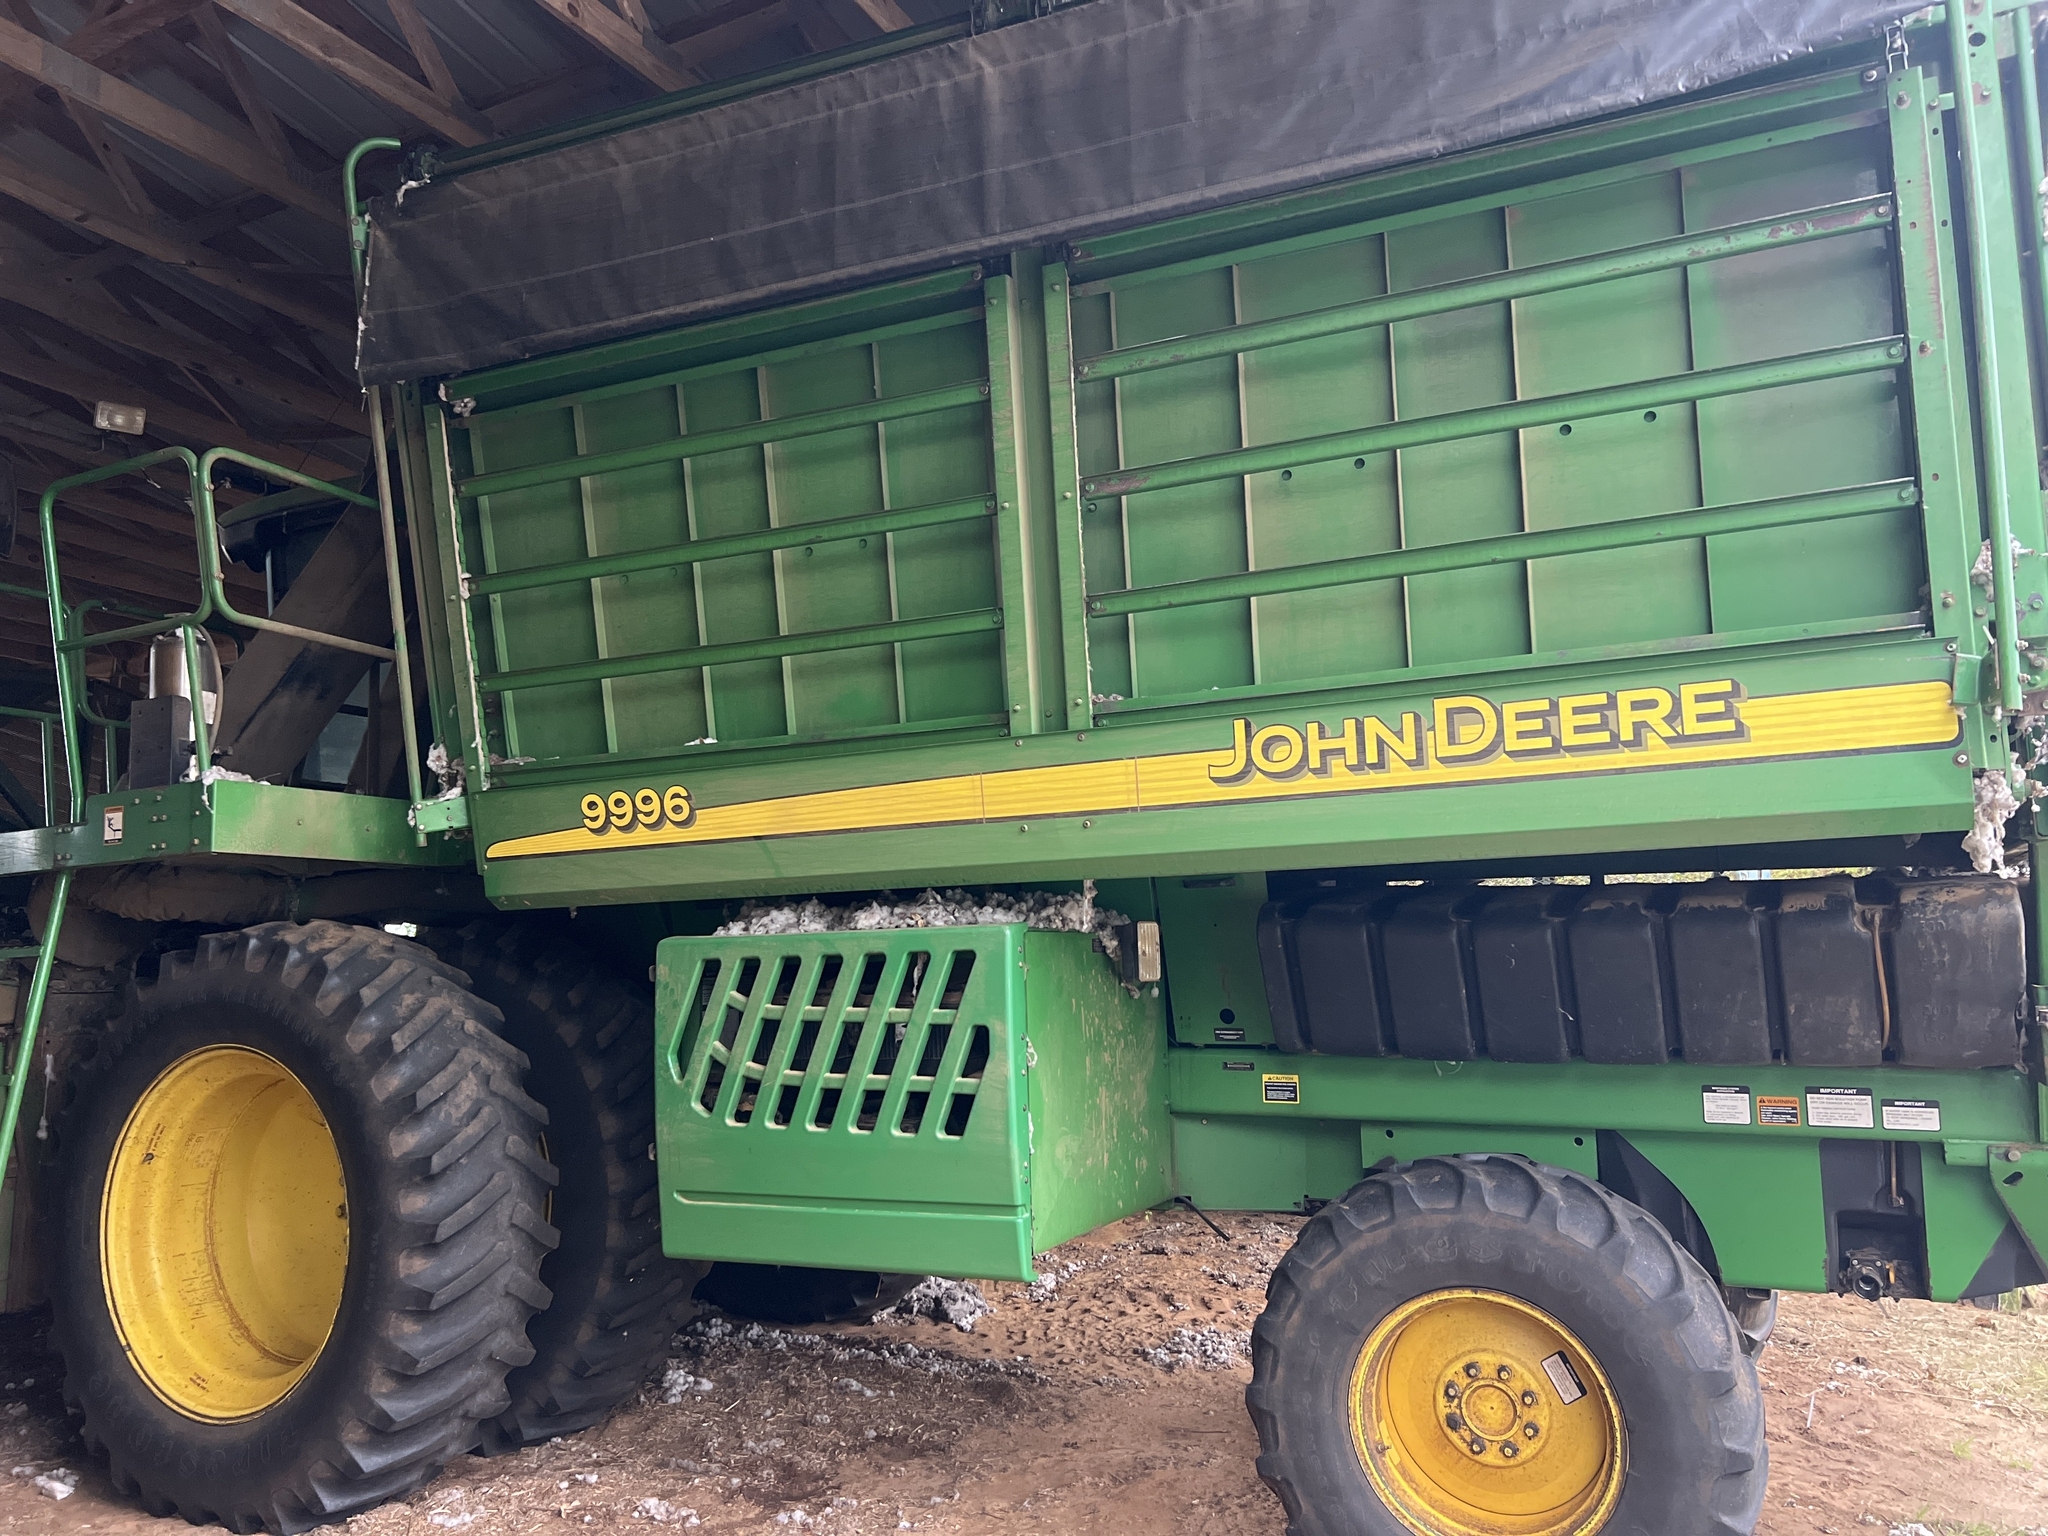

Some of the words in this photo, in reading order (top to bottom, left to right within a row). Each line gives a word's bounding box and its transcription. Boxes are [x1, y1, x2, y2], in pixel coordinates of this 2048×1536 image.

[1208, 711, 1424, 784] JOHN
[1433, 678, 1746, 764] DEERE
[581, 785, 694, 832] 9996
